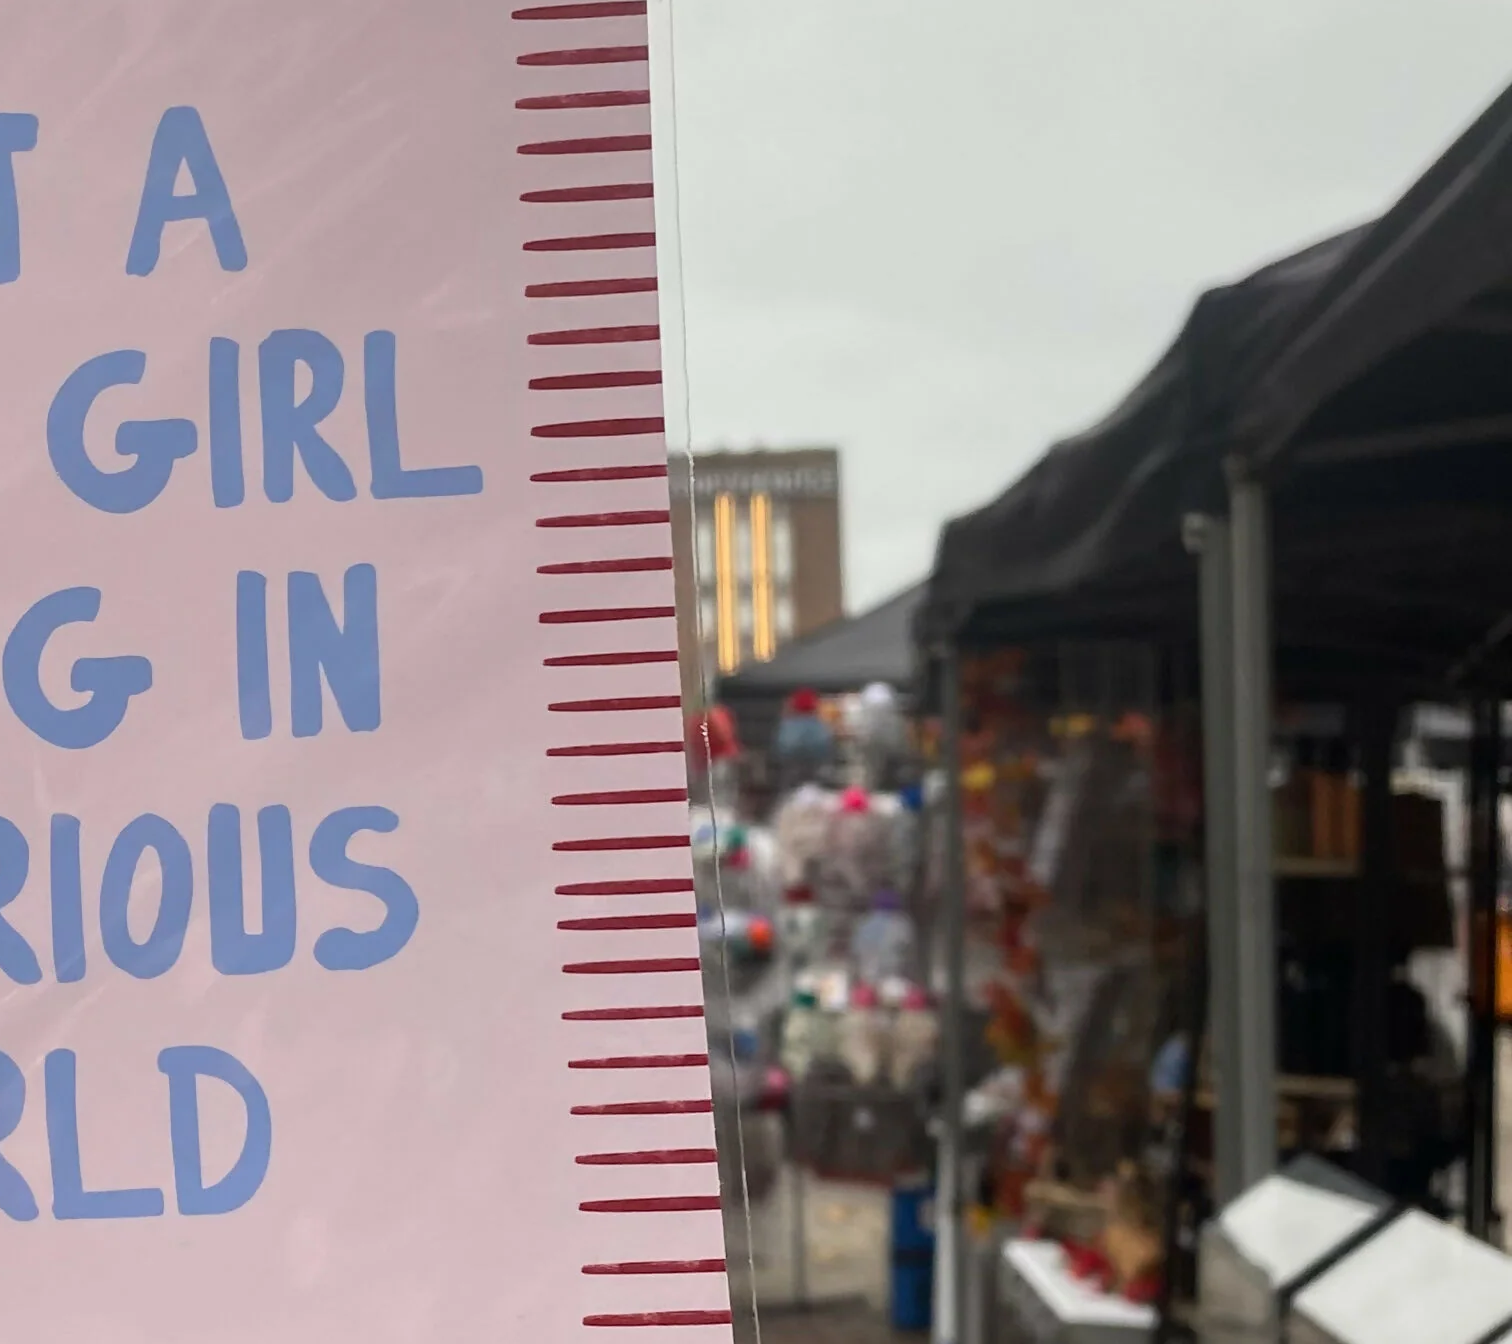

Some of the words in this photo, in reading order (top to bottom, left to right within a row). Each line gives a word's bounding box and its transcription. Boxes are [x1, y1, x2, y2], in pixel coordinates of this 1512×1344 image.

[125, 106, 247, 276] A
[46, 329, 483, 514] GIRL
[236, 563, 381, 740] IN
